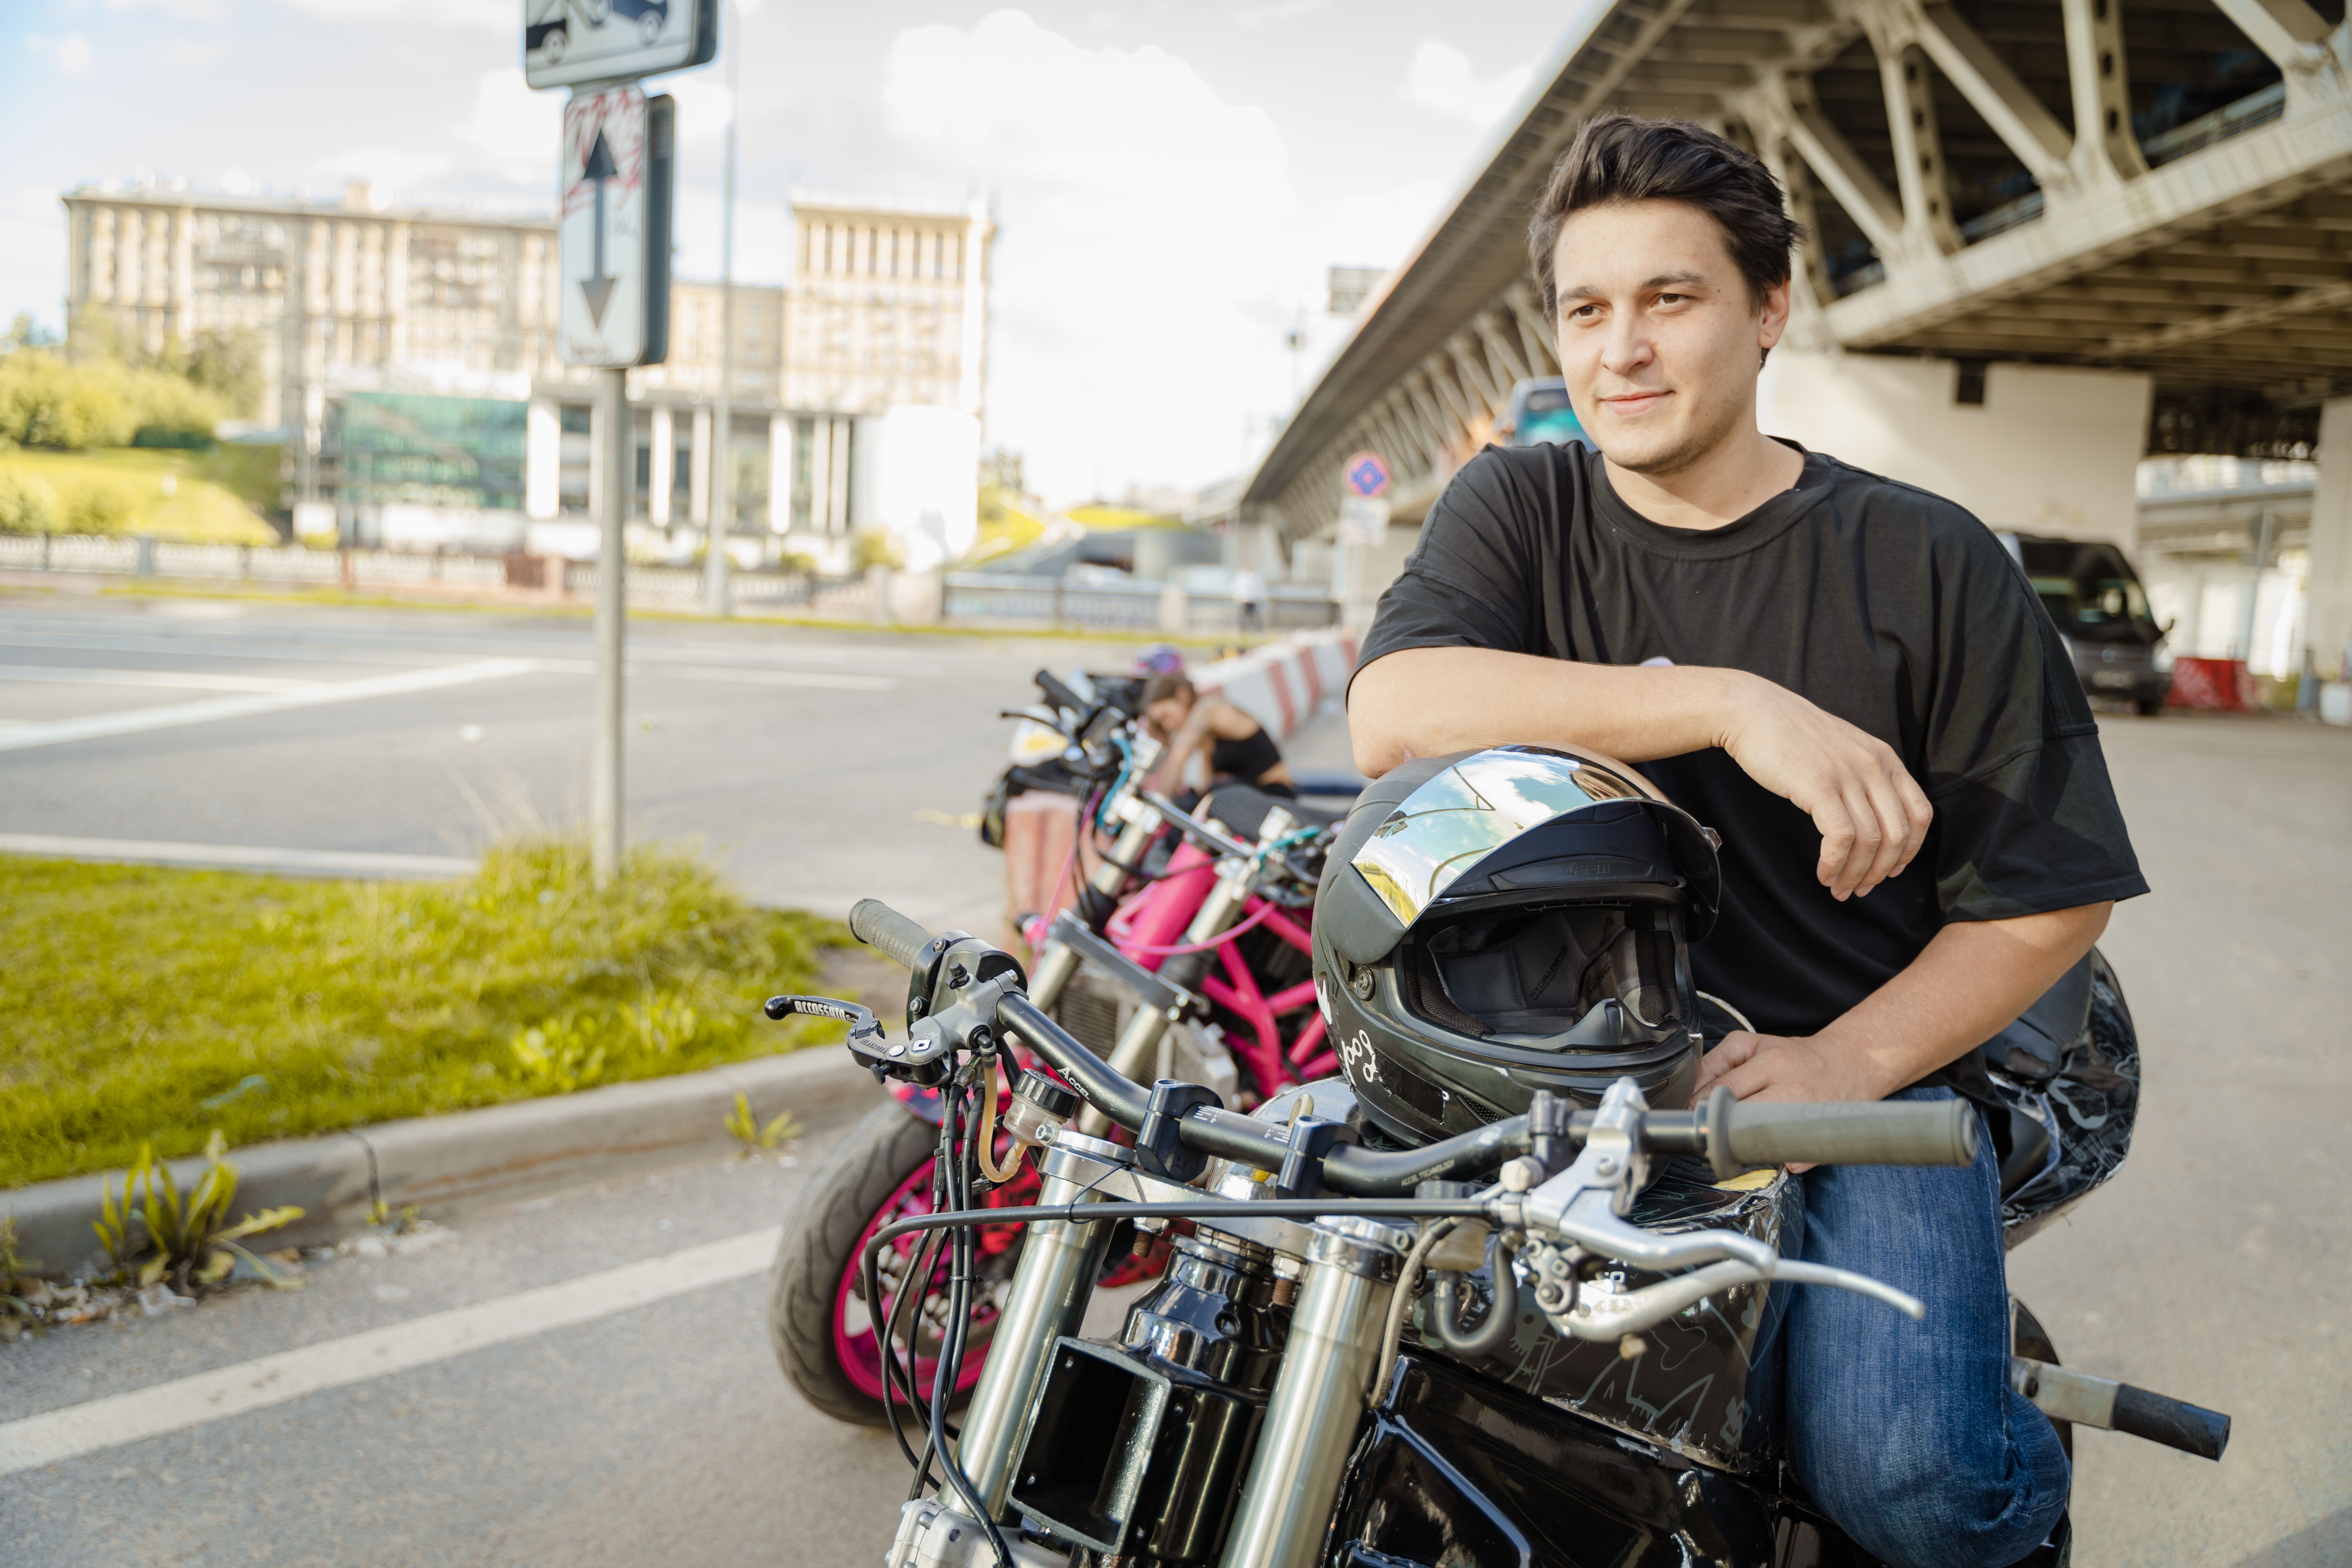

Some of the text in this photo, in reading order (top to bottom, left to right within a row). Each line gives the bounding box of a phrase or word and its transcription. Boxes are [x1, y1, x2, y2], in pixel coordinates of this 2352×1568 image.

[794, 1001, 845, 1019] ACCOSSATO
[1057, 1067, 1090, 1100] ACCEL
[1401, 1159, 1455, 1186] ACCEL TECHNOLOGY
